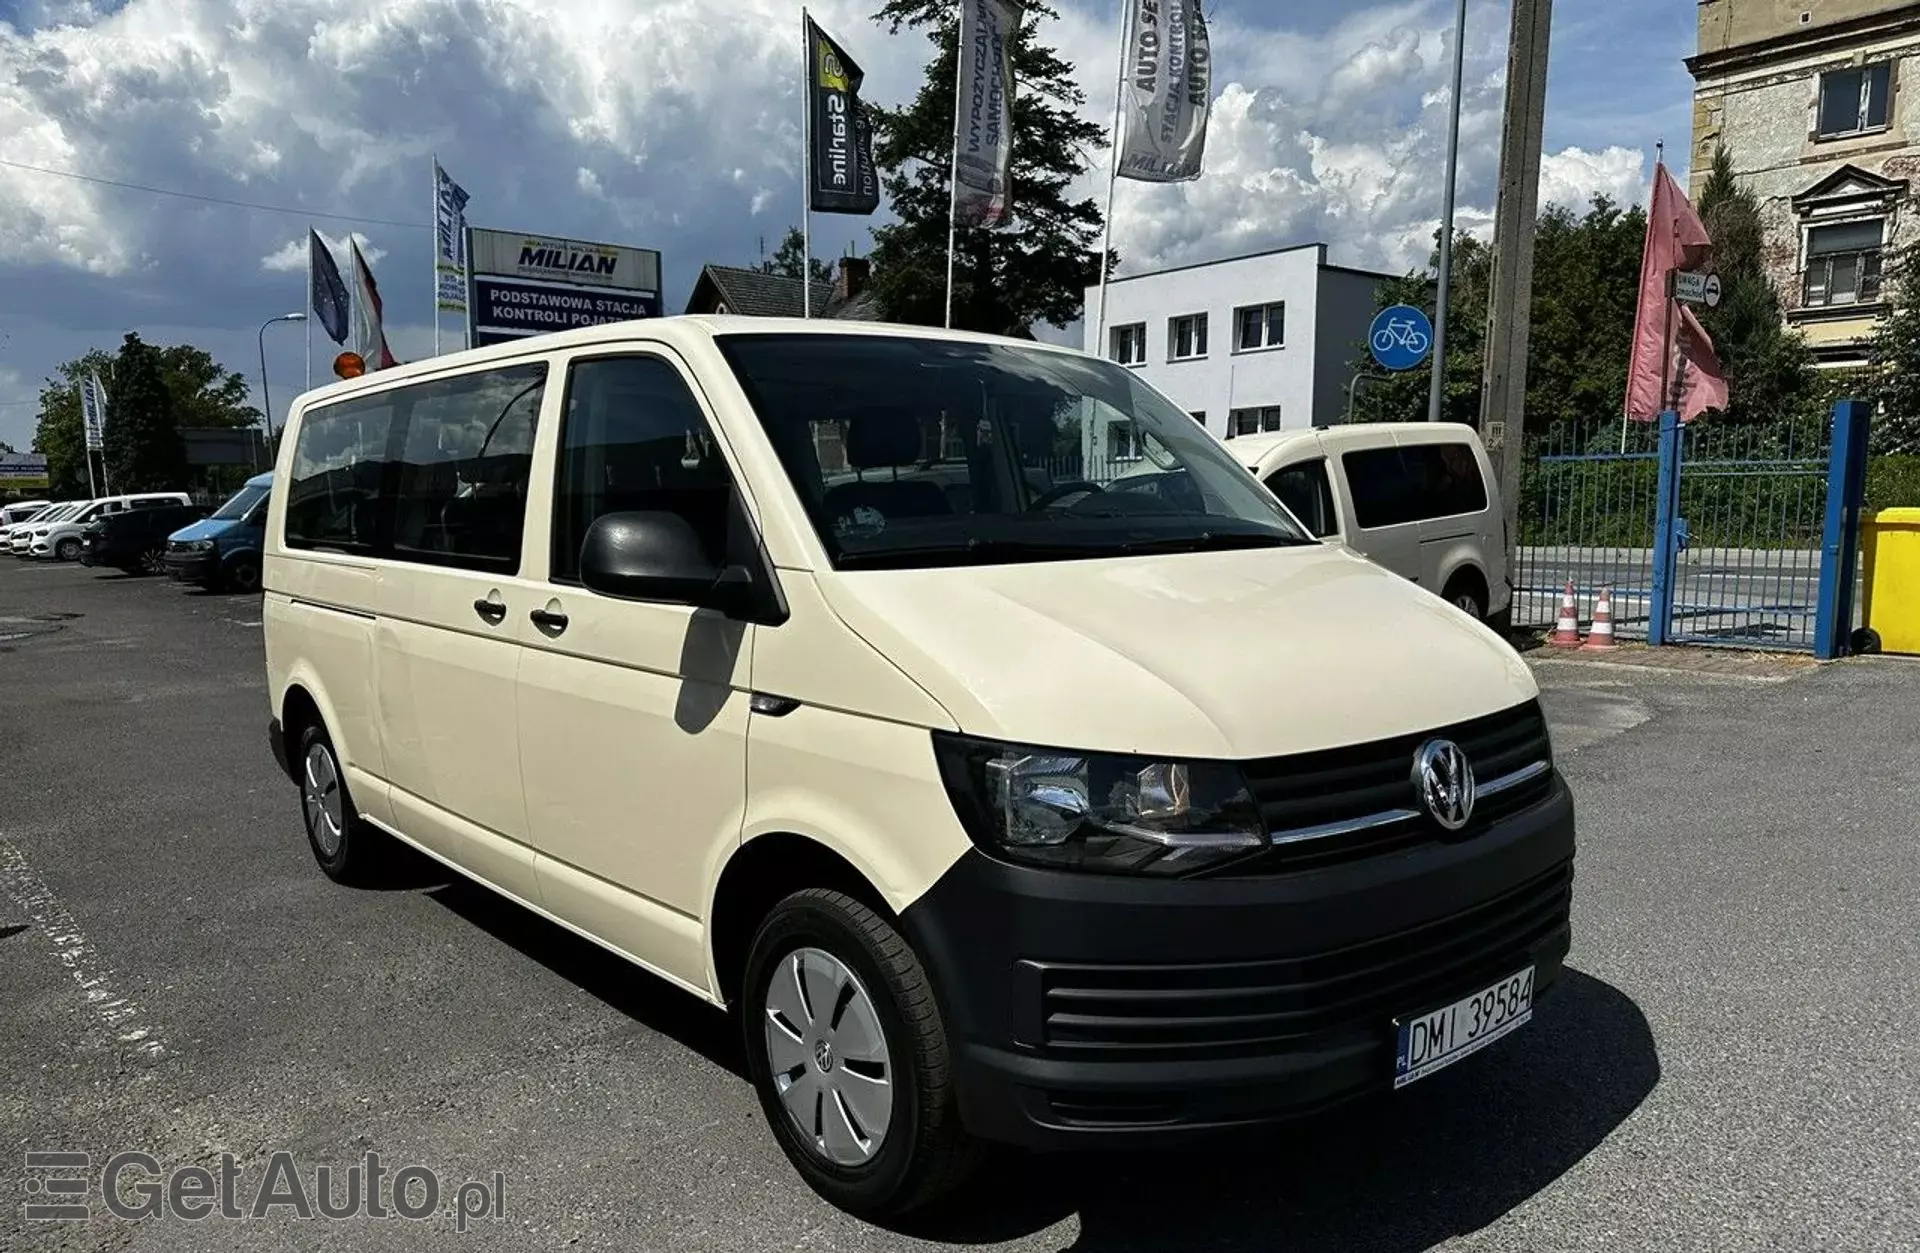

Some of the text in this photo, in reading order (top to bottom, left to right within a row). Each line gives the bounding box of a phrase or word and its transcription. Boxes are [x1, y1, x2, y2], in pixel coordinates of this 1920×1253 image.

[1136, 31, 1160, 93] AUTO
[1188, 48, 1208, 107] AUTO
[1161, 83, 1180, 143] STACJA
[518, 247, 617, 274] MILIAN
[490, 290, 646, 315] PODSTAWOWA STACJA
[493, 306, 567, 324] KONTROLI
[1411, 1007, 1456, 1065] DMI
[1468, 969, 1533, 1038] 39584
